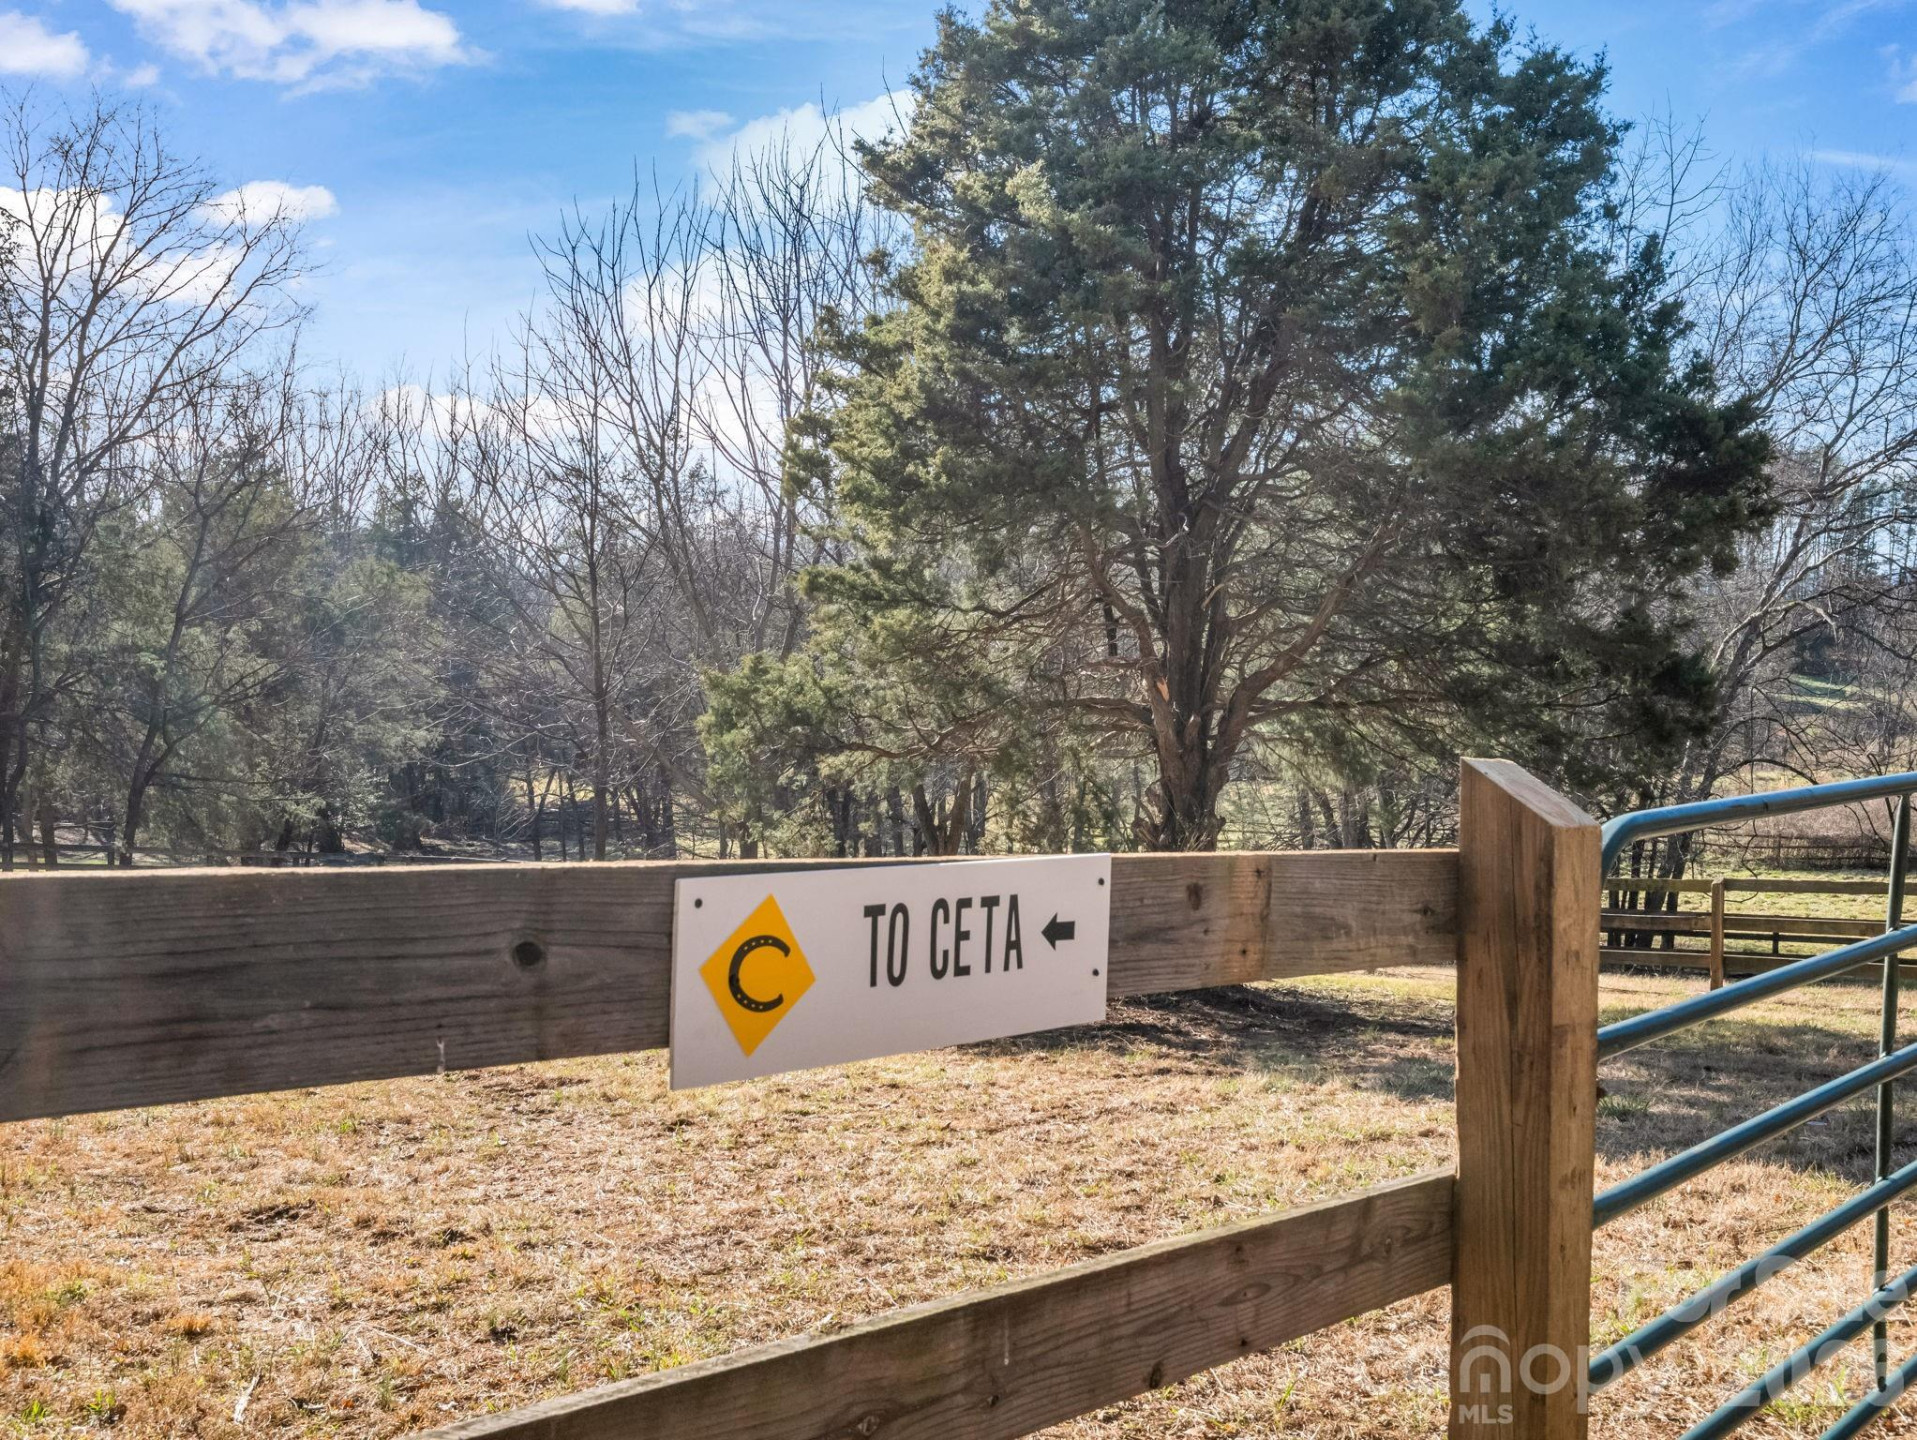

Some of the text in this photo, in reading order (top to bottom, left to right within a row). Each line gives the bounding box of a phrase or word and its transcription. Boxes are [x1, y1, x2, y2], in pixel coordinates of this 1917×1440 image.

[728, 934, 791, 1013] C
[863, 893, 1024, 988] TO CETA
